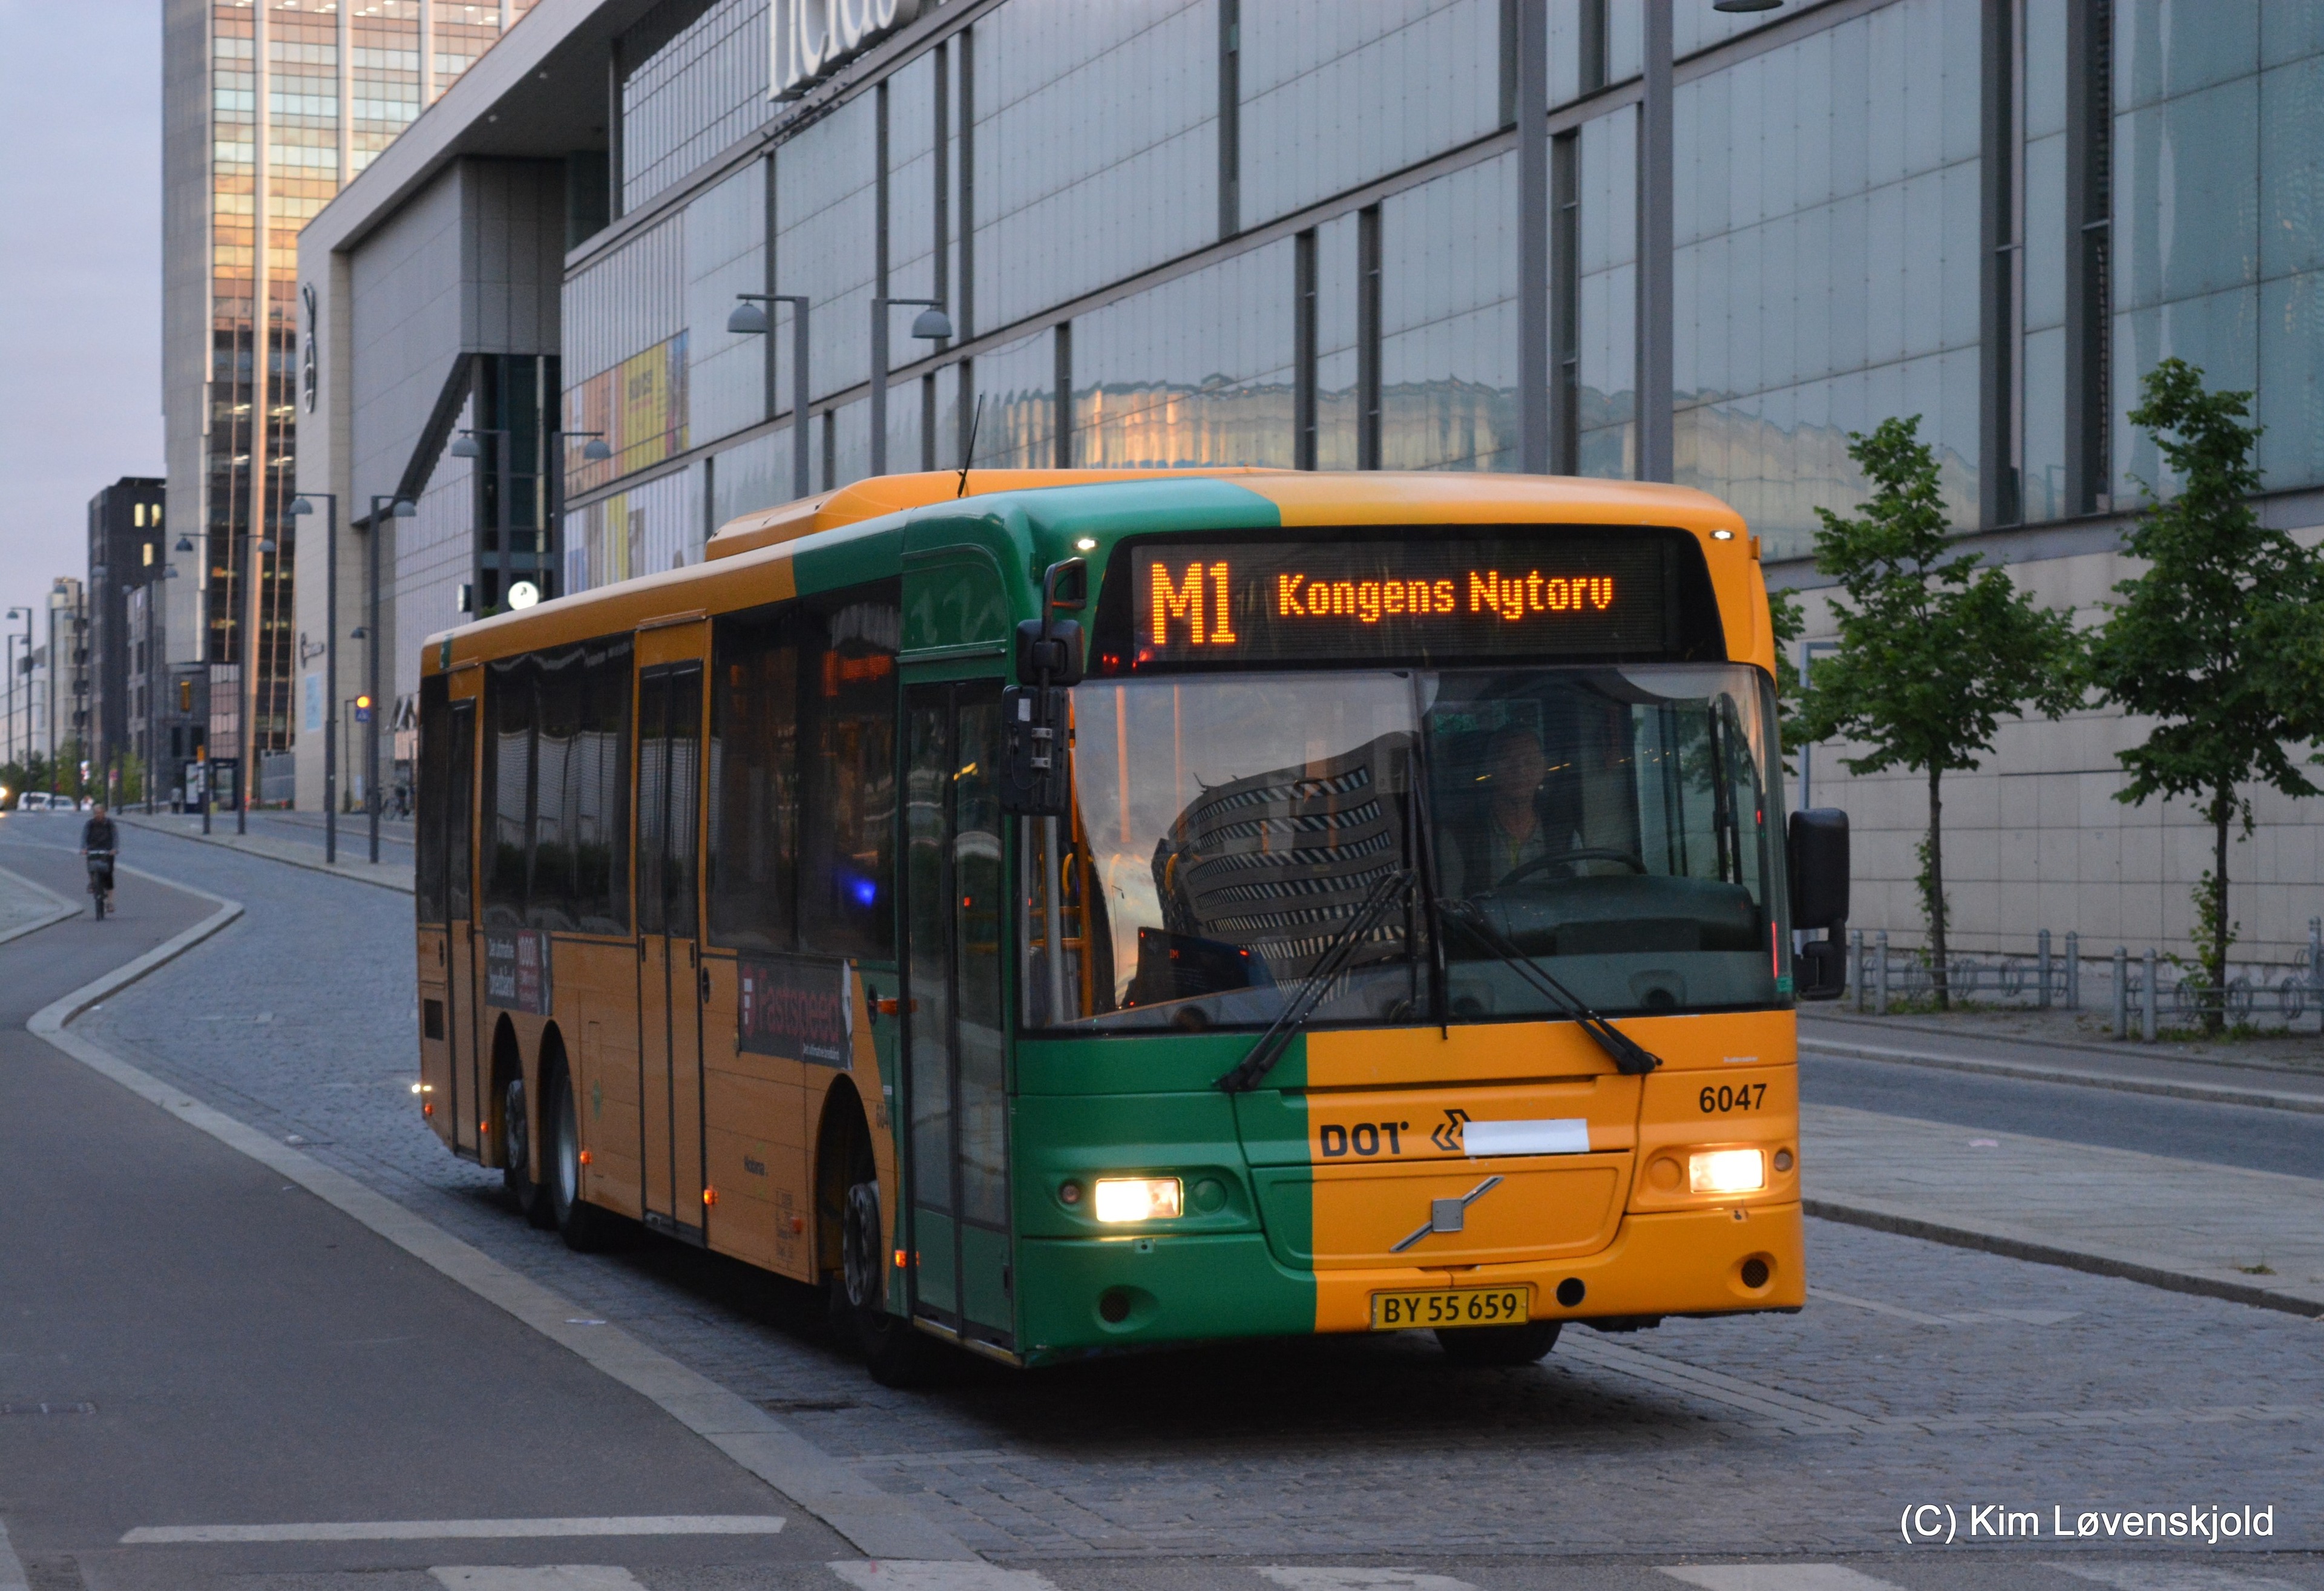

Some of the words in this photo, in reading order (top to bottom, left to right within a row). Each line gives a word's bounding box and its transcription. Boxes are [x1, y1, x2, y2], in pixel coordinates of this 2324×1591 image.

[1152, 562, 1236, 644] M1
[1279, 574, 1454, 623] Kongens
[1469, 571, 1612, 619] Nytorv
[1699, 1083, 1767, 1114] 6047
[1384, 1297, 1420, 1324] BY
[1428, 1296, 1460, 1322] 55
[1468, 1293, 1517, 1320] 659
